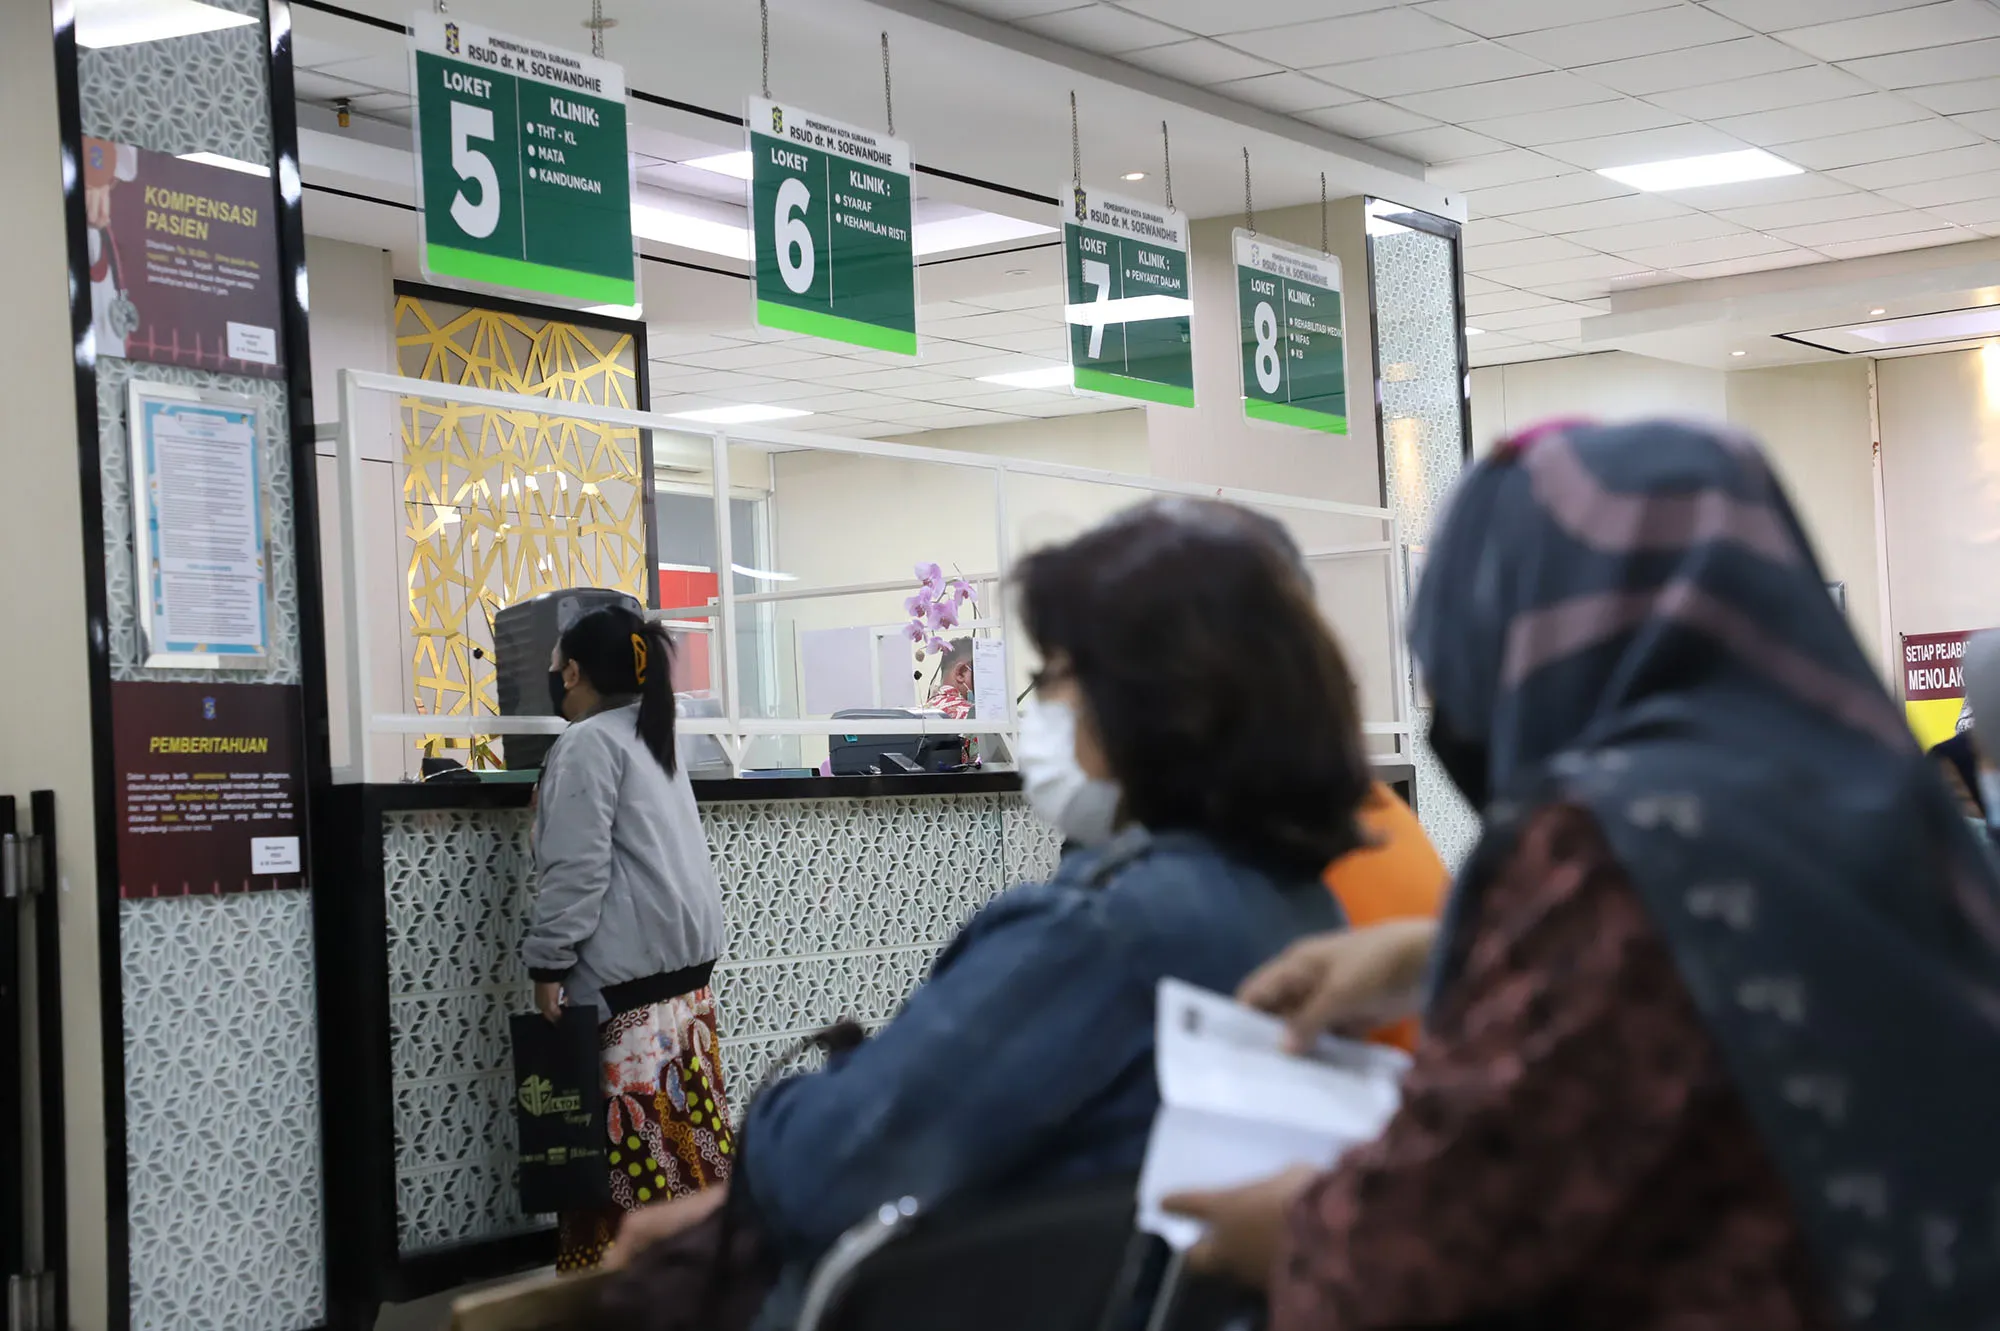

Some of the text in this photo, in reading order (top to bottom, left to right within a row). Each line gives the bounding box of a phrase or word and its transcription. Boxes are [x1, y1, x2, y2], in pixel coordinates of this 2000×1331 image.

[488, 37, 581, 70] PEMERINTAH KOTA SURABAYA
[468, 44, 601, 93] RSUD dr. M. SOEWANDHIE
[443, 69, 492, 99] LOKET
[790, 126, 892, 166] RSUD dr. M. SOEWANDHIE
[806, 119, 876, 147] PEMERINTAH KOTA SURABAYA
[450, 100, 500, 238] 5
[538, 146, 565, 165] MATA
[771, 147, 808, 173] LOKET
[539, 168, 601, 194] KANDUNGAN
[144, 185, 257, 228] KOMPENSASI
[843, 195, 872, 213] SYARAF
[145, 210, 209, 241] PASIEN
[774, 178, 815, 294] 6
[843, 214, 907, 242] KEHAMILAN RISTI
[1090, 209, 1178, 243] RSUD dr. M. SOEWANDHIE
[1079, 236, 1107, 255] LOKET
[1131, 269, 1181, 289] PENYAKIT DALAM
[1251, 278, 1275, 297] LOKET
[1082, 258, 1110, 360] 7
[1294, 318, 1327, 334] REHABILITASI
[1295, 333, 1310, 346] NIFAS
[1254, 301, 1280, 394] 8
[1905, 641, 1971, 662] SETIAP PEJABA
[1908, 666, 1966, 690] MENOLAK
[149, 736, 269, 753] PEMBERITAHUAN
